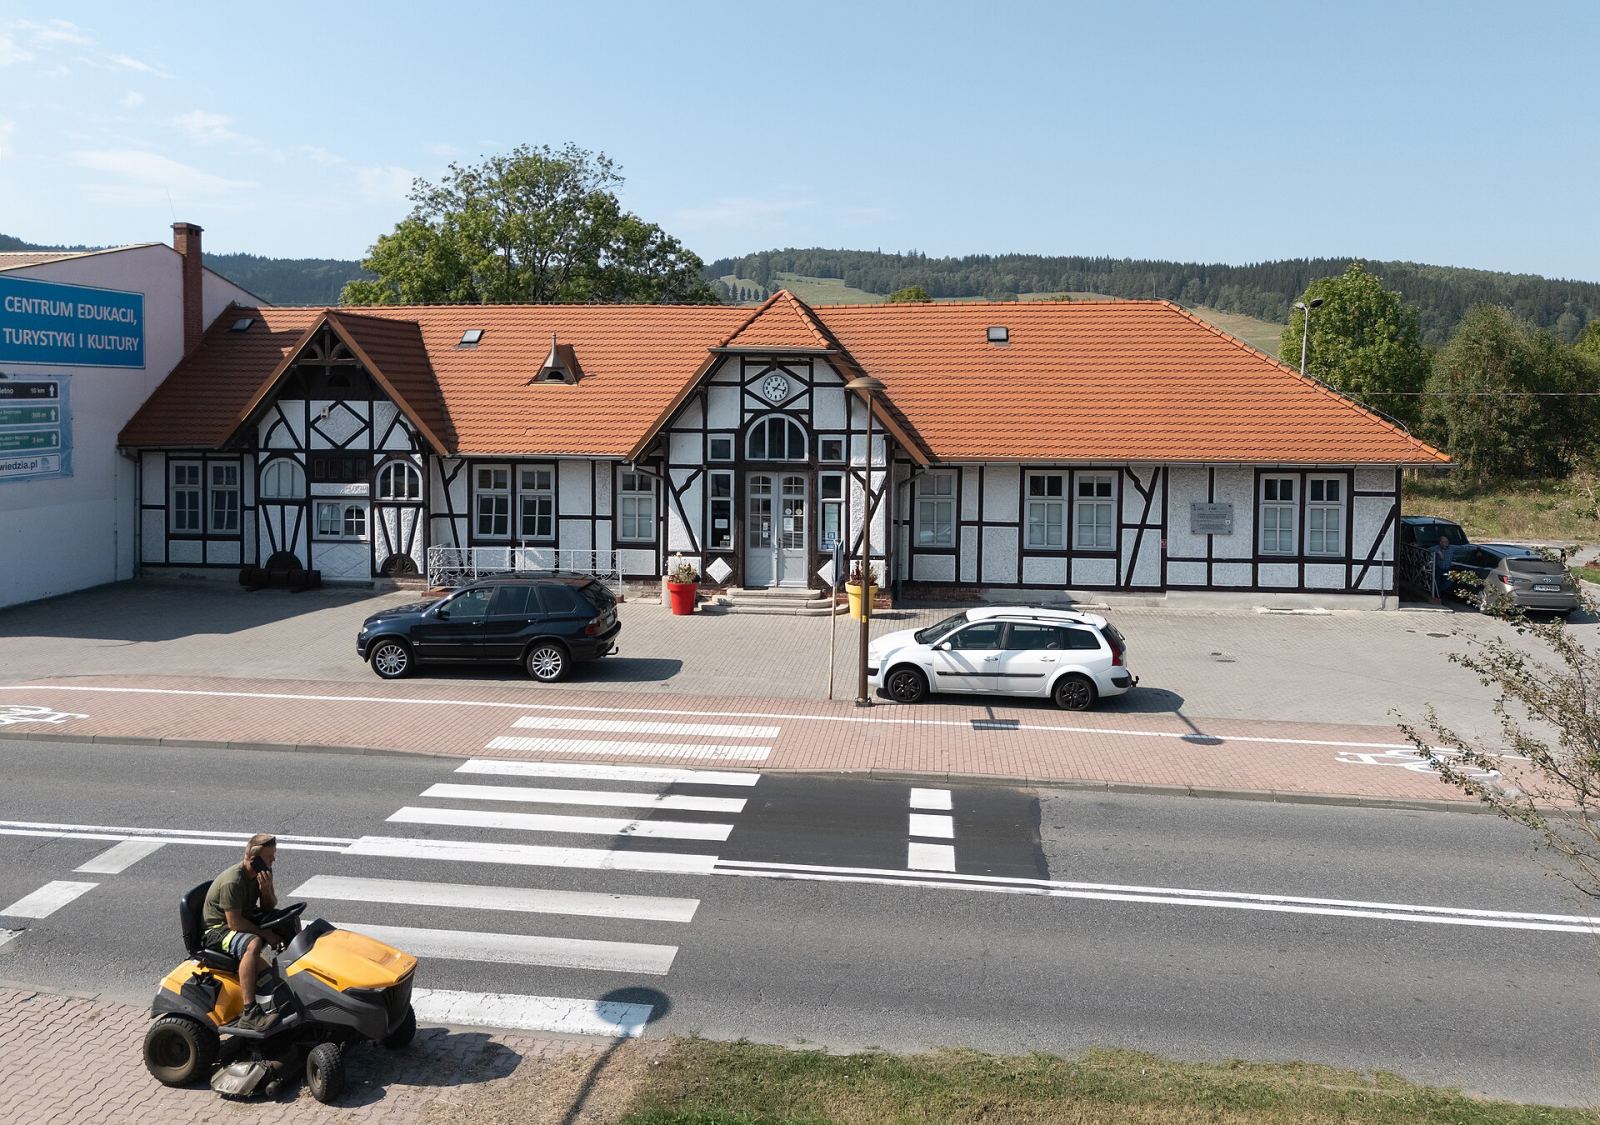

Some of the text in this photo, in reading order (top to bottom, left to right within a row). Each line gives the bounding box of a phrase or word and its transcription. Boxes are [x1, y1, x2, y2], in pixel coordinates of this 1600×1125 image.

[4, 296, 137, 325] CENTRUM EDUKACJI,
[3, 328, 139, 351] TURYSTYKI I KULTURY
